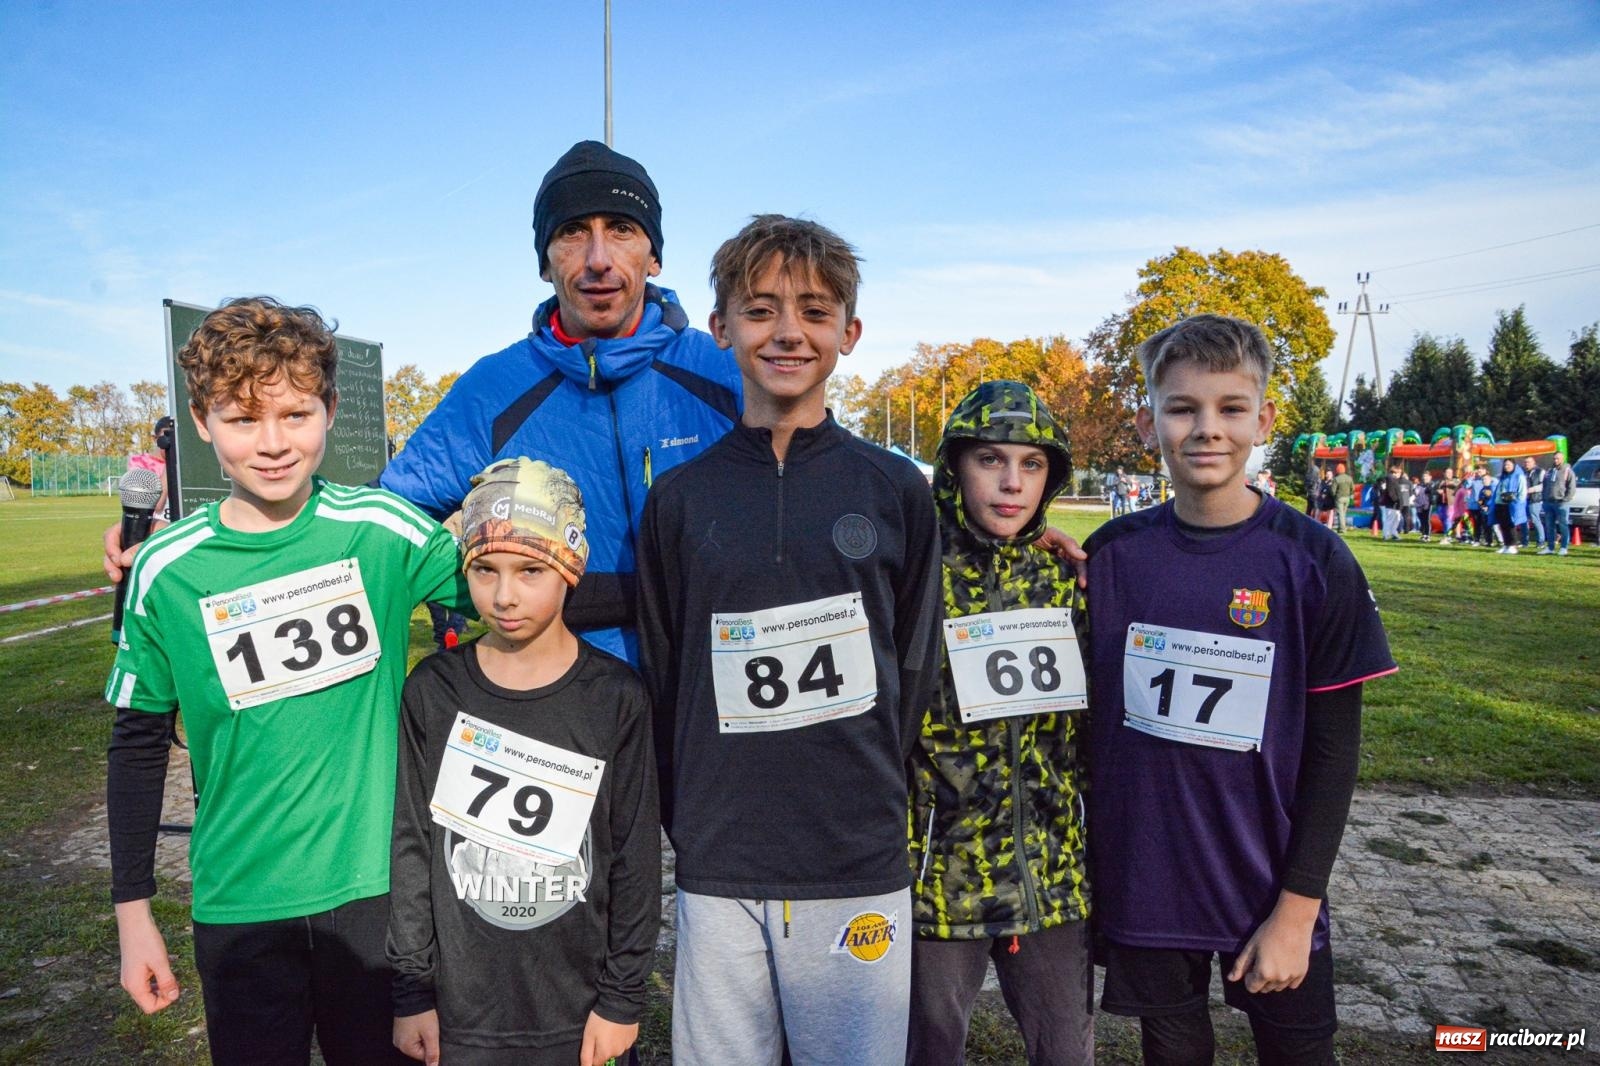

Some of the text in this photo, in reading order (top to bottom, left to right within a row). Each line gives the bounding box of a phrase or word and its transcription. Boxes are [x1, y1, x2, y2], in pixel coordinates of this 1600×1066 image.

[514, 503, 557, 526] MebRaj
[261, 572, 353, 606] www.personalbest.pl
[761, 607, 857, 634] www.personalbest.pl
[998, 618, 1068, 631] www.personalbest.pl
[226, 603, 369, 684] 138
[1171, 641, 1267, 664] www.personalbest.pl
[744, 643, 845, 709] 84
[985, 645, 1062, 697] 68
[1149, 667, 1234, 725] 17
[503, 745, 593, 781] www.personalbest.pl
[466, 764, 554, 837] 79
[451, 872, 588, 903] WINTER
[501, 905, 537, 918] 2020
